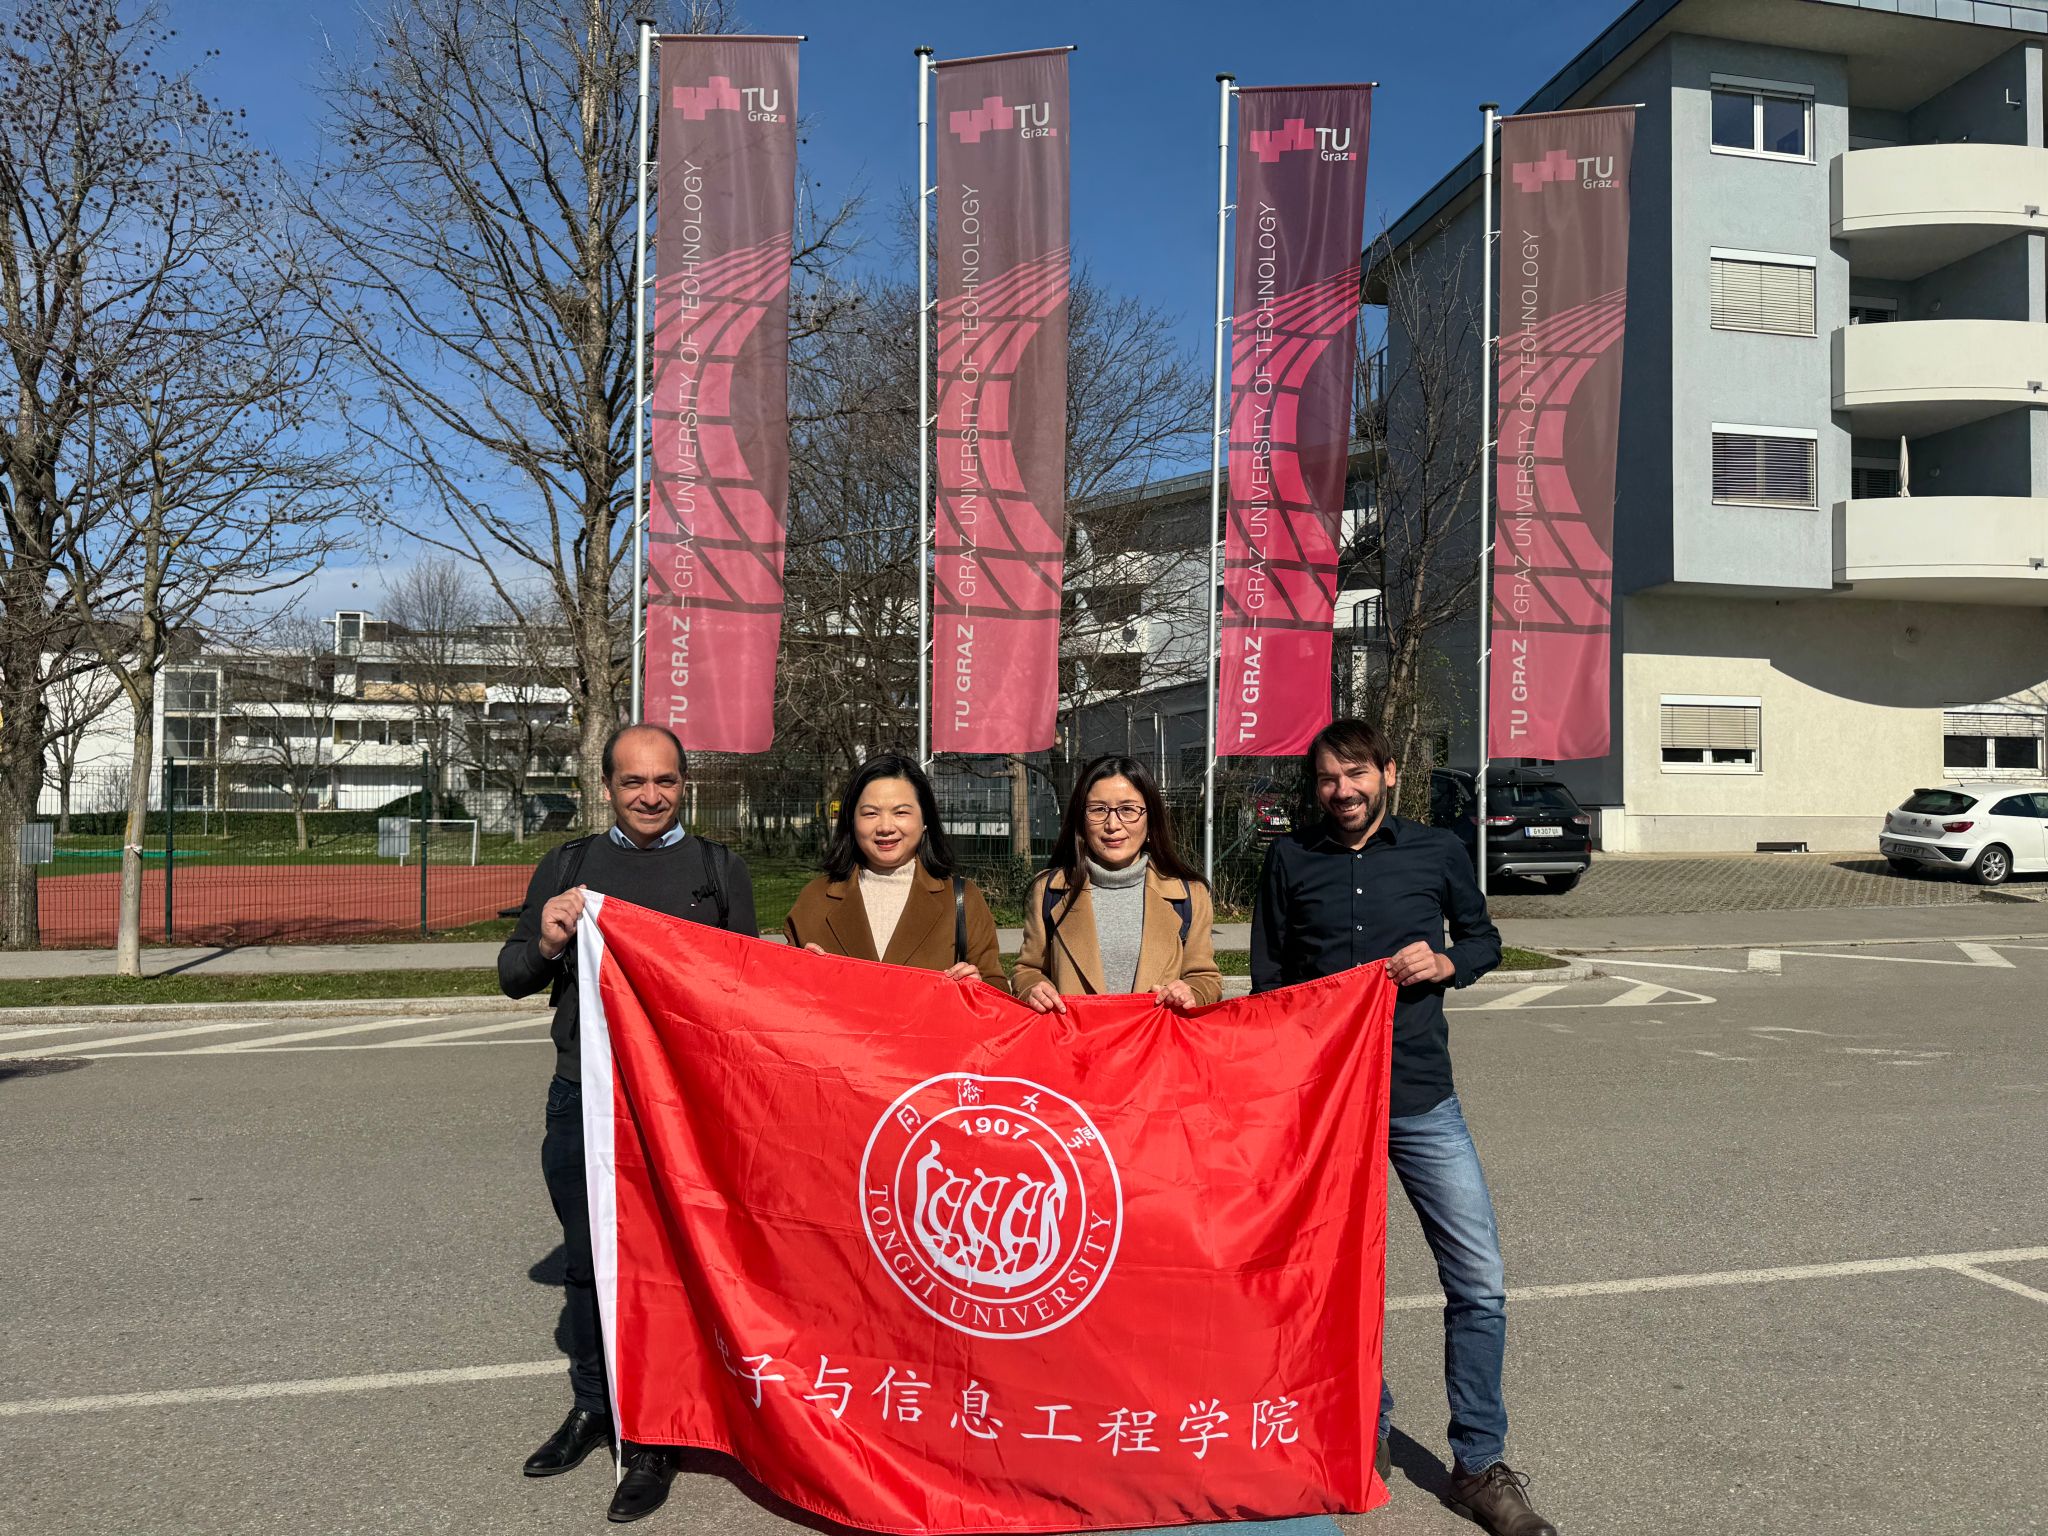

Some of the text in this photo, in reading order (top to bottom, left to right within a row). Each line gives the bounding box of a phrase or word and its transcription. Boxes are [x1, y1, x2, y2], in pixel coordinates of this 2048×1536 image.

[742, 88, 779, 112] TU
[747, 111, 778, 123] Graz
[1014, 102, 1050, 128] TU
[1021, 127, 1049, 139] Graz
[1315, 127, 1351, 151] TU
[1320, 151, 1349, 162] Graz
[1577, 156, 1614, 179] TU
[1582, 178, 1612, 190] Graz
[680, 159, 702, 324] TECHNOLOGY
[961, 184, 980, 346] TECHNOLOGY
[1255, 201, 1276, 360] TECHNOLOGY
[1520, 230, 1539, 378] TECHNOLOGY
[680, 330, 699, 365] OF
[961, 354, 980, 385] OF
[1254, 365, 1272, 396] OF
[1519, 385, 1536, 413] OF
[676, 372, 699, 513] UNIVERSITY
[961, 392, 980, 525] UNIVERSITY
[1249, 404, 1270, 538] UNIVERSITY
[1515, 421, 1535, 547] UNIVERSITY
[674, 522, 695, 588] GRAZ
[958, 534, 977, 597] GRAZ
[1246, 546, 1266, 610] GRAZ
[1513, 555, 1531, 614] GRAZ
[671, 616, 690, 687] GRAZ
[956, 624, 974, 693] GRAZ
[1241, 636, 1262, 704] GRAZ
[1510, 639, 1528, 702] GRAZ
[668, 695, 688, 727] TU
[955, 699, 970, 732] TU
[1239, 711, 1258, 743] TU
[1510, 709, 1528, 740] TU
[958, 1116, 1030, 1141] 1907
[868, 1184, 1112, 1328] TONGJI UNIVERSITY
